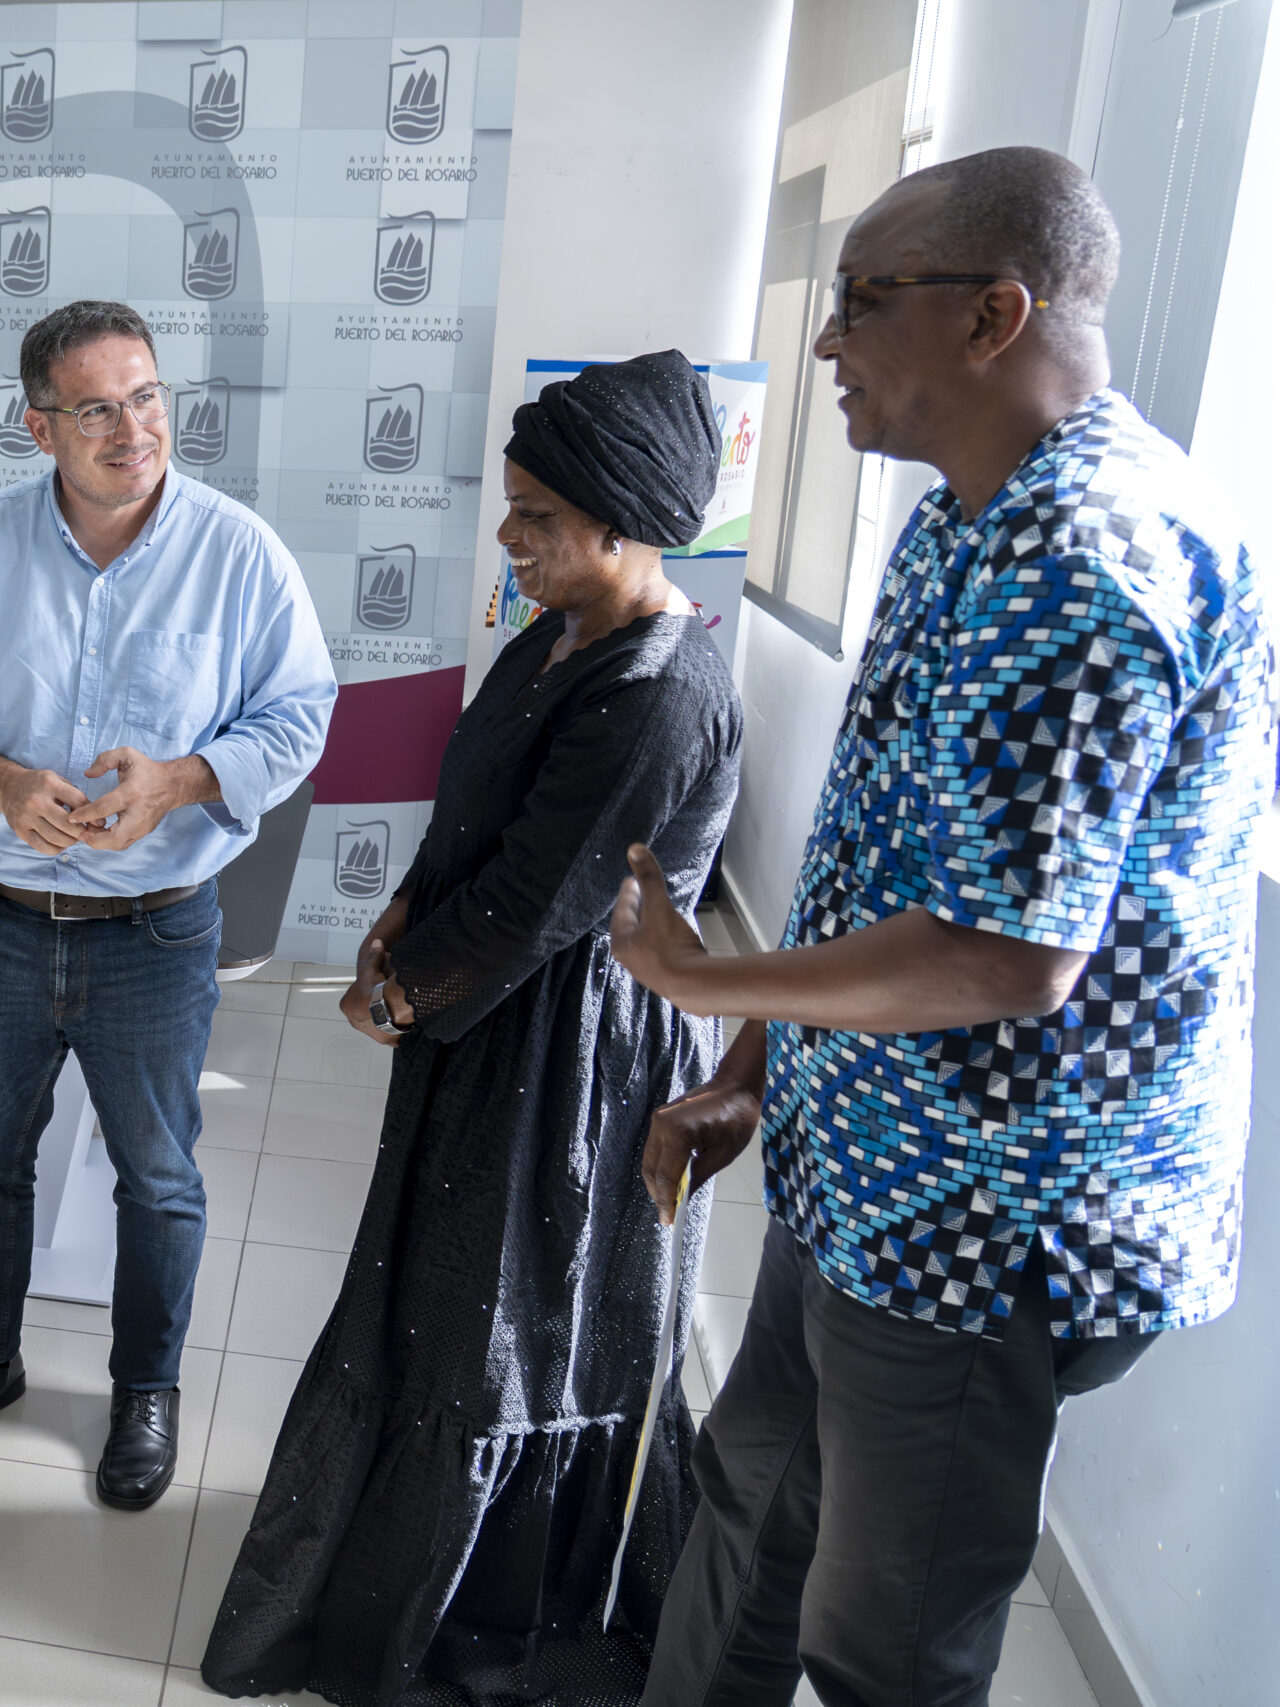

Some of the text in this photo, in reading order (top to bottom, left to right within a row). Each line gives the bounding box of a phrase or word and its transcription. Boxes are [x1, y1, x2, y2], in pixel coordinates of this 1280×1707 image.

[154, 154, 278, 162] AYUNTAMIENTO
[348, 156, 478, 164] AYUNTAMIENTO
[13, 165, 32, 178] DEL
[38, 165, 86, 178] ROSARIO
[152, 166, 277, 180] PUERTO DEL ROSARIO
[346, 168, 478, 182] PUERTO DEL ROSARIO
[148, 310, 269, 320] AYUNTAMIENTO
[338, 316, 464, 326] AYUNTAMIENTO
[10, 319, 28, 330] DEL
[194, 323, 214, 336] DEL
[221, 324, 269, 336] ROSARIO
[334, 327, 463, 342] PUERTO DEL ROSARIO
[328, 482, 452, 494] AYUNTAMIENTO
[326, 494, 451, 510] PUERTO DEL ROSARIO
[332, 638, 442, 651] YUNTAMIENTO
[330, 648, 442, 666] ERTO DEL ROSARIO
[300, 904, 384, 916] AYUNTAMI
[298, 913, 340, 927] PUERTO
[344, 917, 364, 929] DEL
